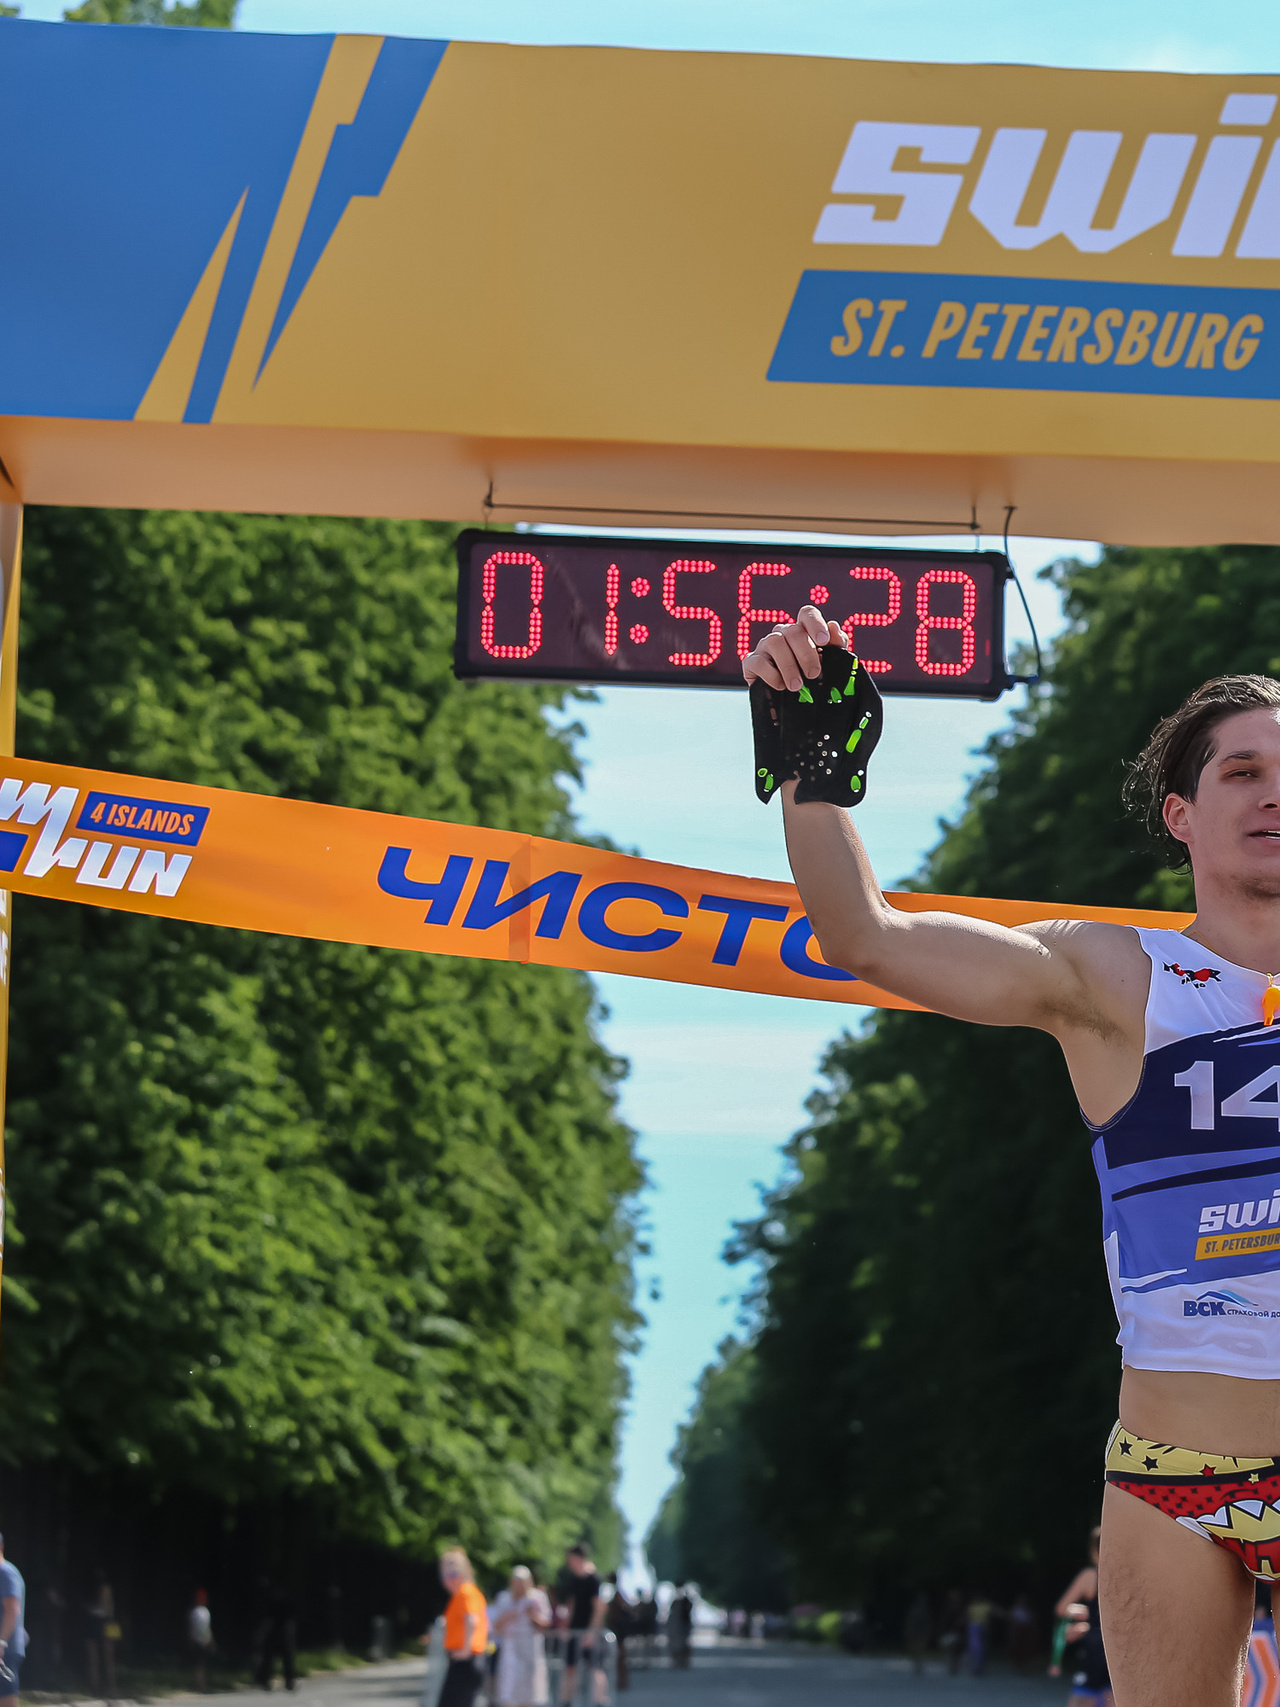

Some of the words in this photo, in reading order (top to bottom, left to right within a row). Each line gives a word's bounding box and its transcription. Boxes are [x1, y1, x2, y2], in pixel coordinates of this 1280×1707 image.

[828, 297, 908, 360] ST.
[919, 299, 1266, 372] PETERSBURG
[89, 802, 104, 823] 4
[105, 805, 196, 837] ISLANDS
[1204, 1240, 1219, 1254] ST.
[1183, 1300, 1228, 1317] ВСК
[1226, 1308, 1270, 1318] СТРАХОВОЙ
